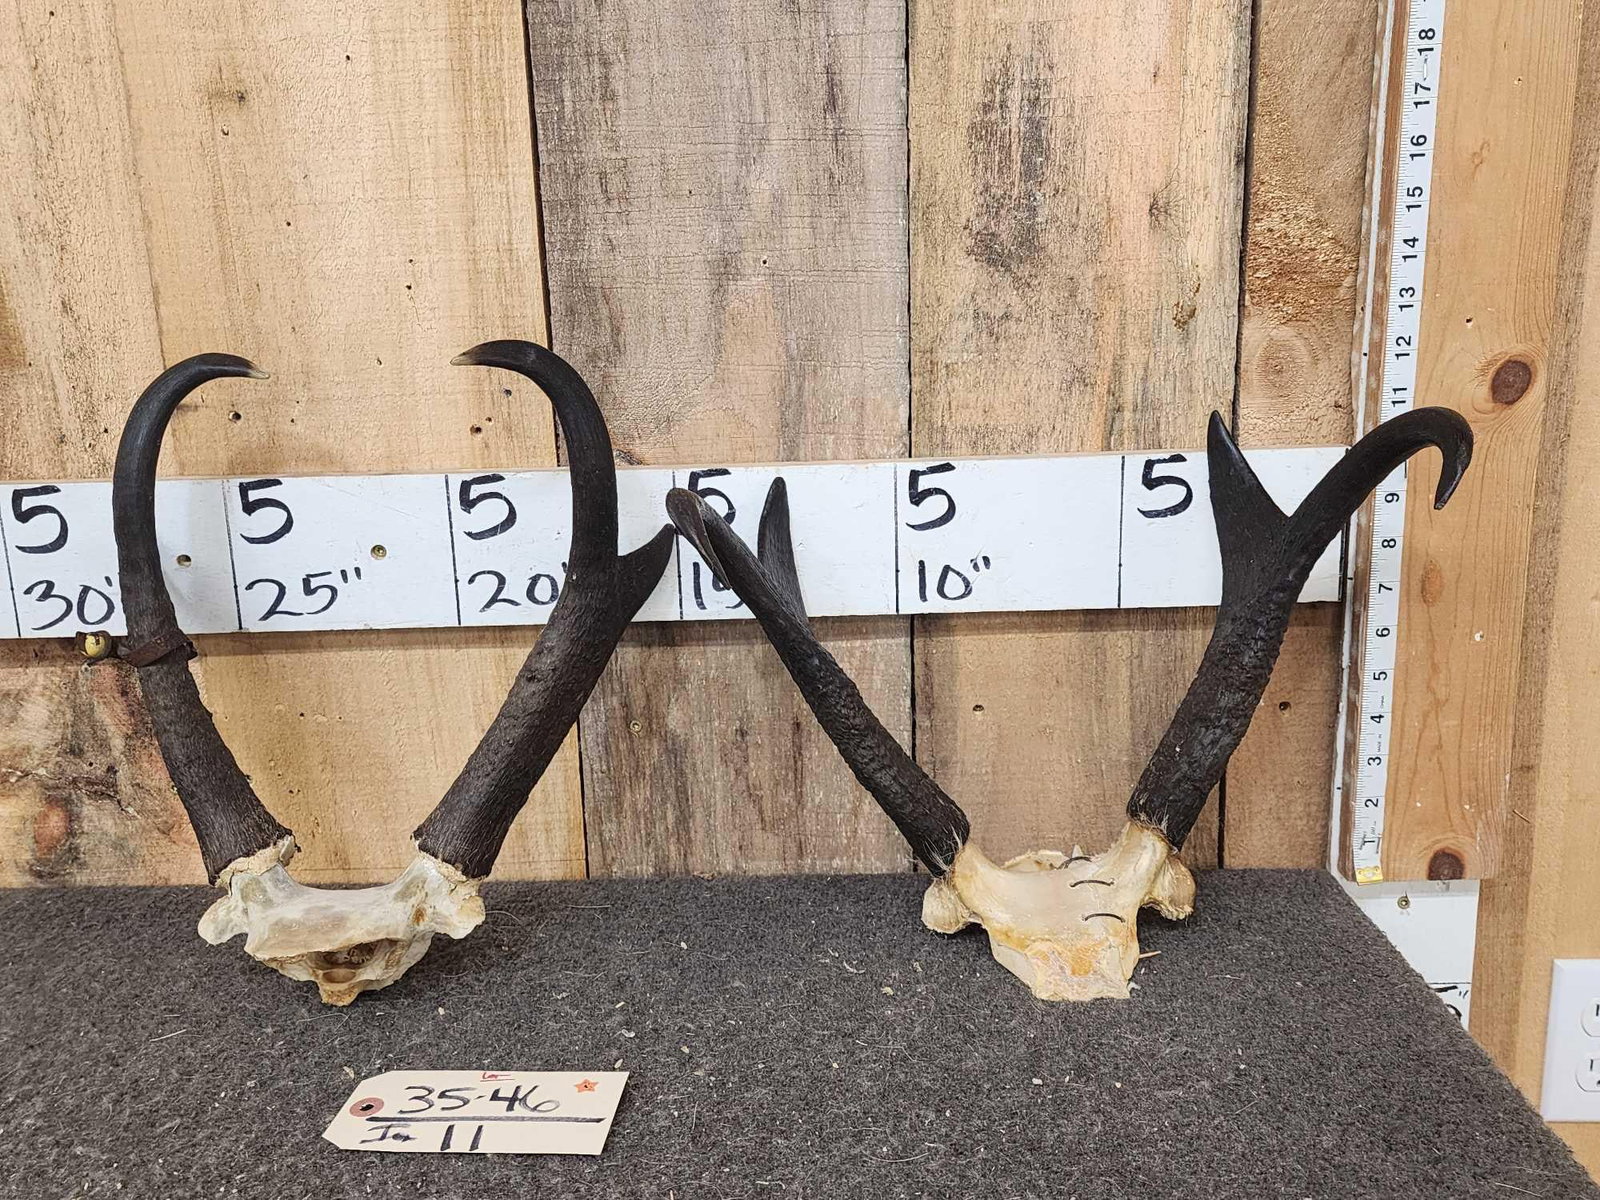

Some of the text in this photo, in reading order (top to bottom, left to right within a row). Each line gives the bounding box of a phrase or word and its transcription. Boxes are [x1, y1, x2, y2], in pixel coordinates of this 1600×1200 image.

[1417, 27, 1436, 56] 18
[1413, 82, 1431, 109] 17
[1409, 134, 1427, 161] 16
[1405, 186, 1423, 212] 15
[1401, 236, 1419, 262] 14
[1398, 286, 1415, 312] 13
[1394, 335, 1412, 360] 12
[1391, 387, 1408, 408] 11
[905, 462, 956, 531] 5
[1137, 453, 1193, 519] 5
[1384, 492, 1400, 504] 9
[11, 485, 69, 554] 5
[238, 478, 294, 545] 5
[459, 473, 517, 540] 5
[1381, 538, 1397, 549] 8
[918, 555, 991, 602] 10"
[1378, 583, 1393, 594] 7
[244, 566, 362, 622] 25"
[1375, 627, 1391, 638] 6
[1373, 671, 1388, 681] 5
[1370, 713, 1385, 724] 4
[1367, 756, 1382, 766] 3
[1364, 798, 1379, 808] 2
[440, 1124, 484, 1151] 11
